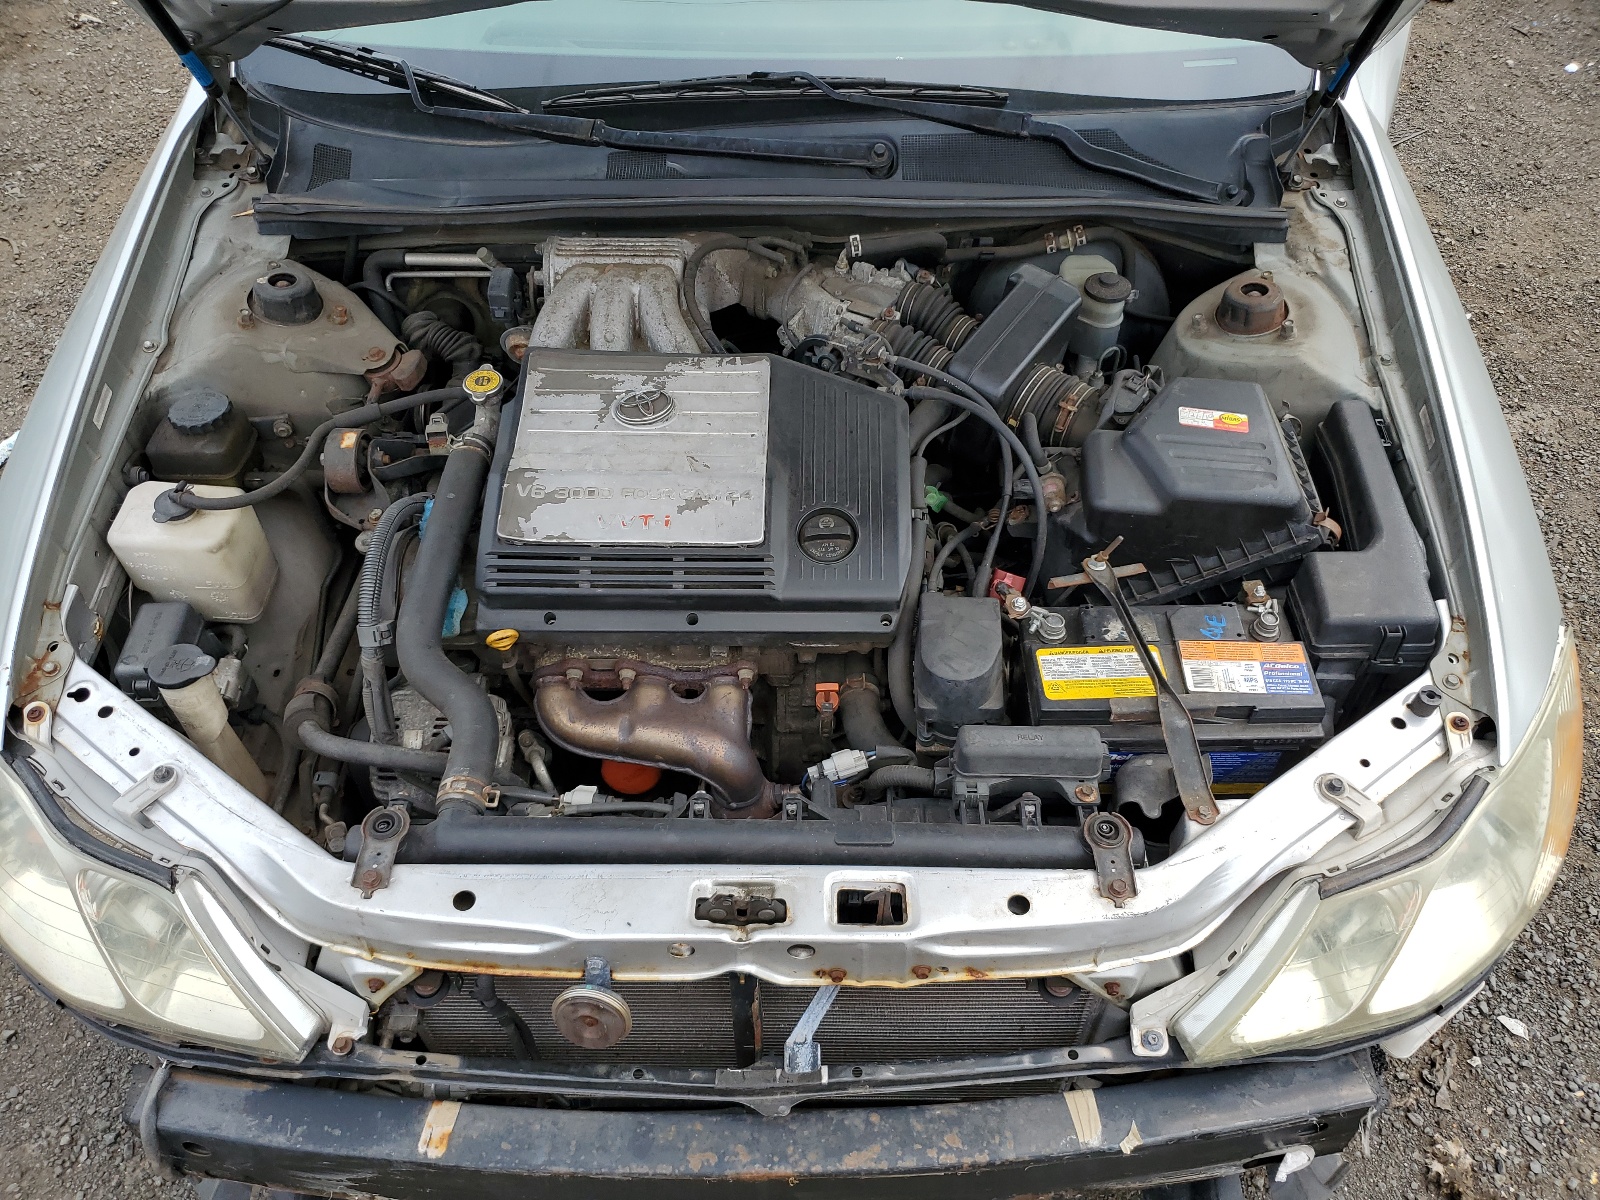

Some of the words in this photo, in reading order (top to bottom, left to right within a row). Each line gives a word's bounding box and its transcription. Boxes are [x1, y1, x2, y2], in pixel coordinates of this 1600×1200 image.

[517, 483, 546, 499] V6
[621, 487, 677, 500] FOUR
[597, 513, 672, 530] VVT-i
[1017, 733, 1044, 741] RELAY
